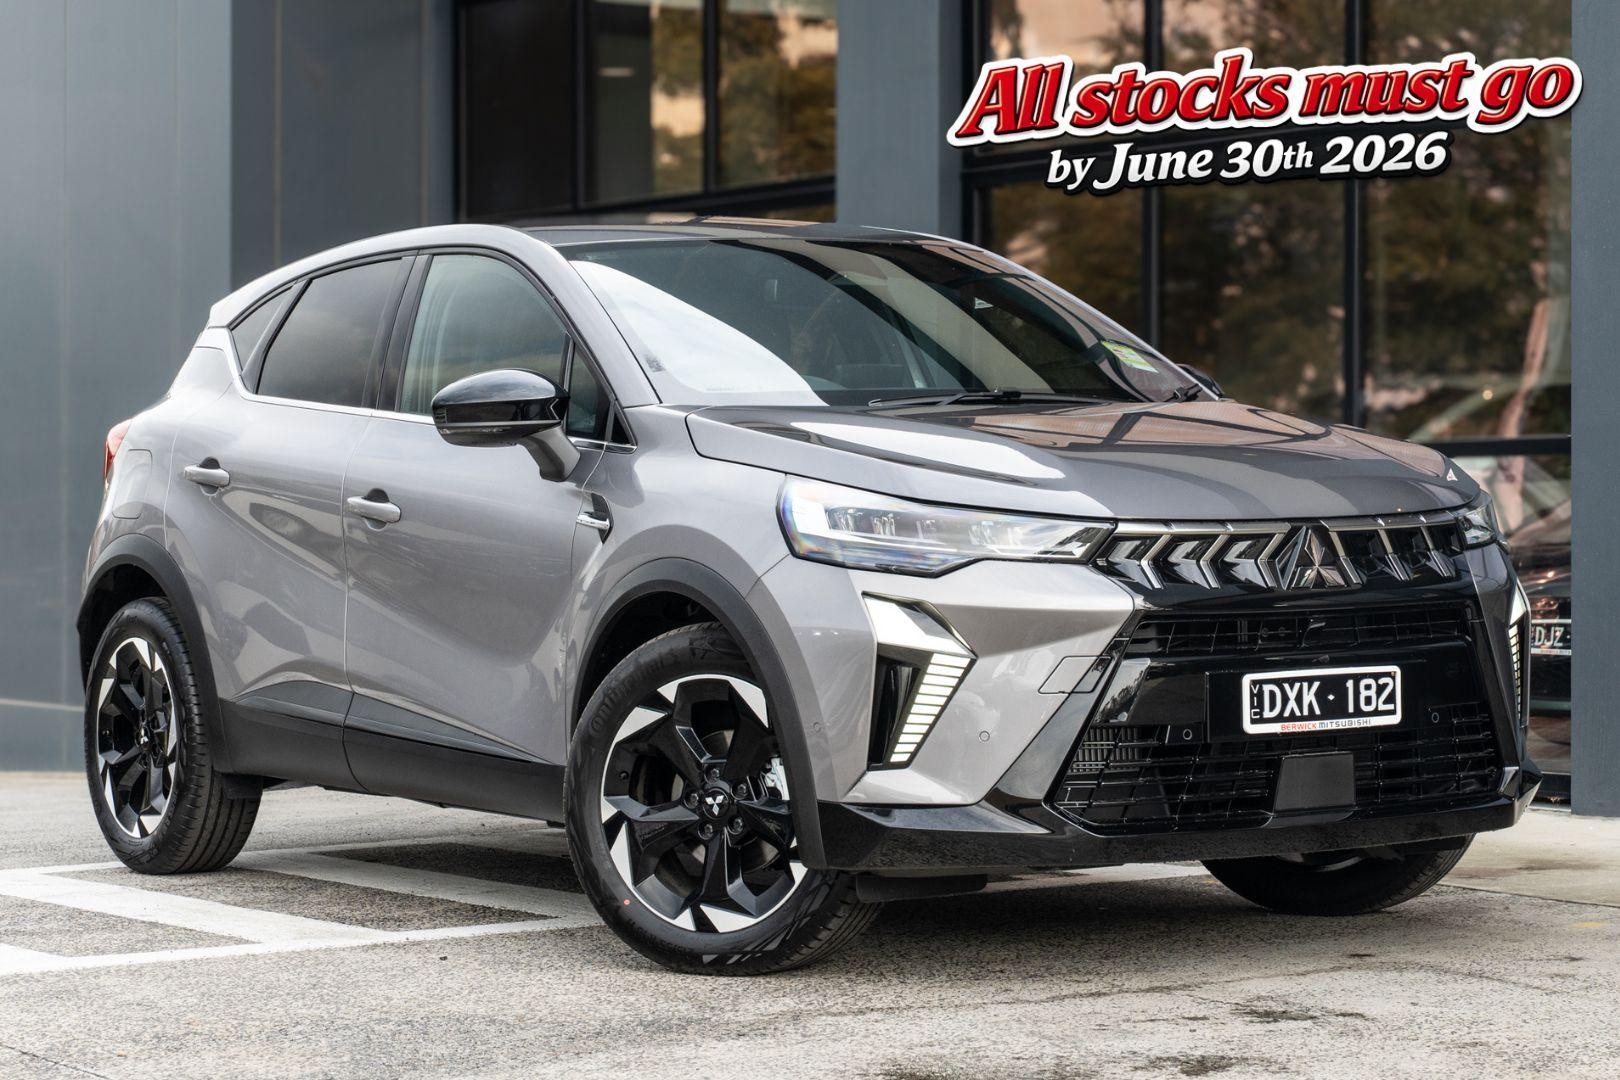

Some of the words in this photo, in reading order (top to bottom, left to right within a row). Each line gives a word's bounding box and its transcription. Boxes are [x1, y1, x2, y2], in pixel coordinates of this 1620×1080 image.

[1534, 626, 1565, 648] DJZ
[1251, 684, 1260, 719] VIC
[1262, 681, 1321, 719] DXK
[1346, 677, 1395, 713] 182
[1280, 722, 1317, 731] BERWICK
[1318, 718, 1371, 729] MITSUBISHI
